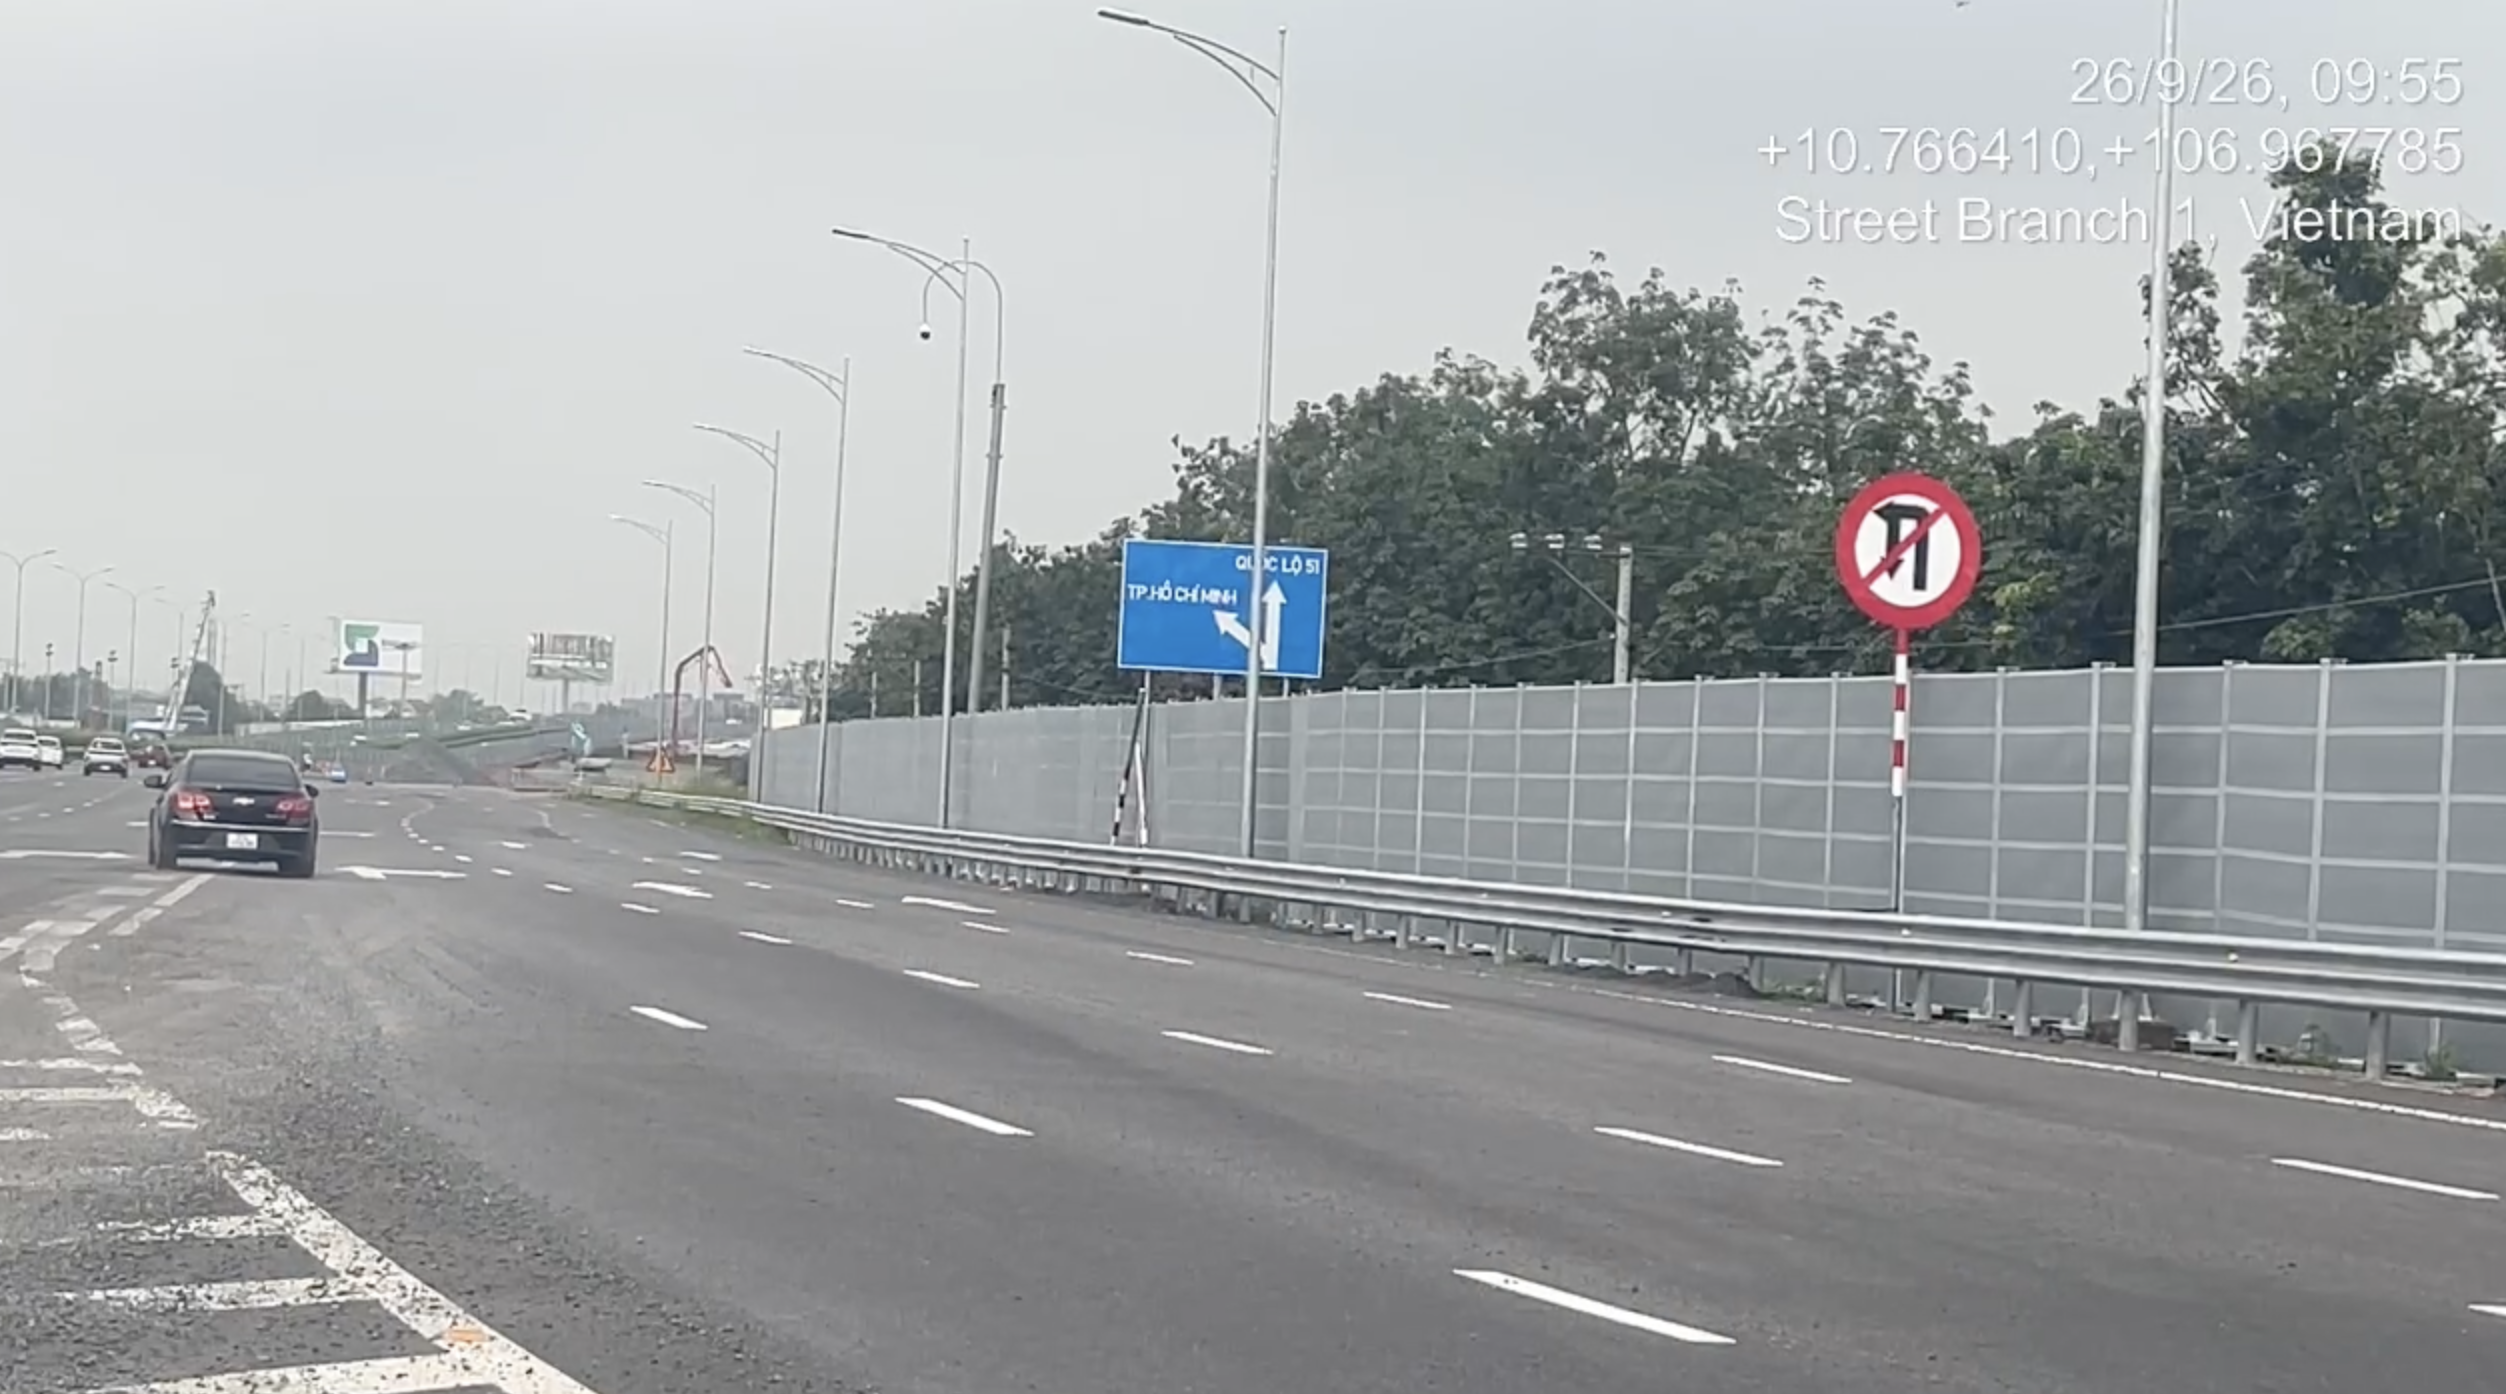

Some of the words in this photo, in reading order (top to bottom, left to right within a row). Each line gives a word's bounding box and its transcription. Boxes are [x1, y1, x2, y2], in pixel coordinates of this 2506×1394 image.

[1281, 555, 1302, 576] LỘ
[1305, 559, 1320, 574] 51
[1174, 585, 1200, 602] CHÍ
[1201, 588, 1237, 606] MINH
